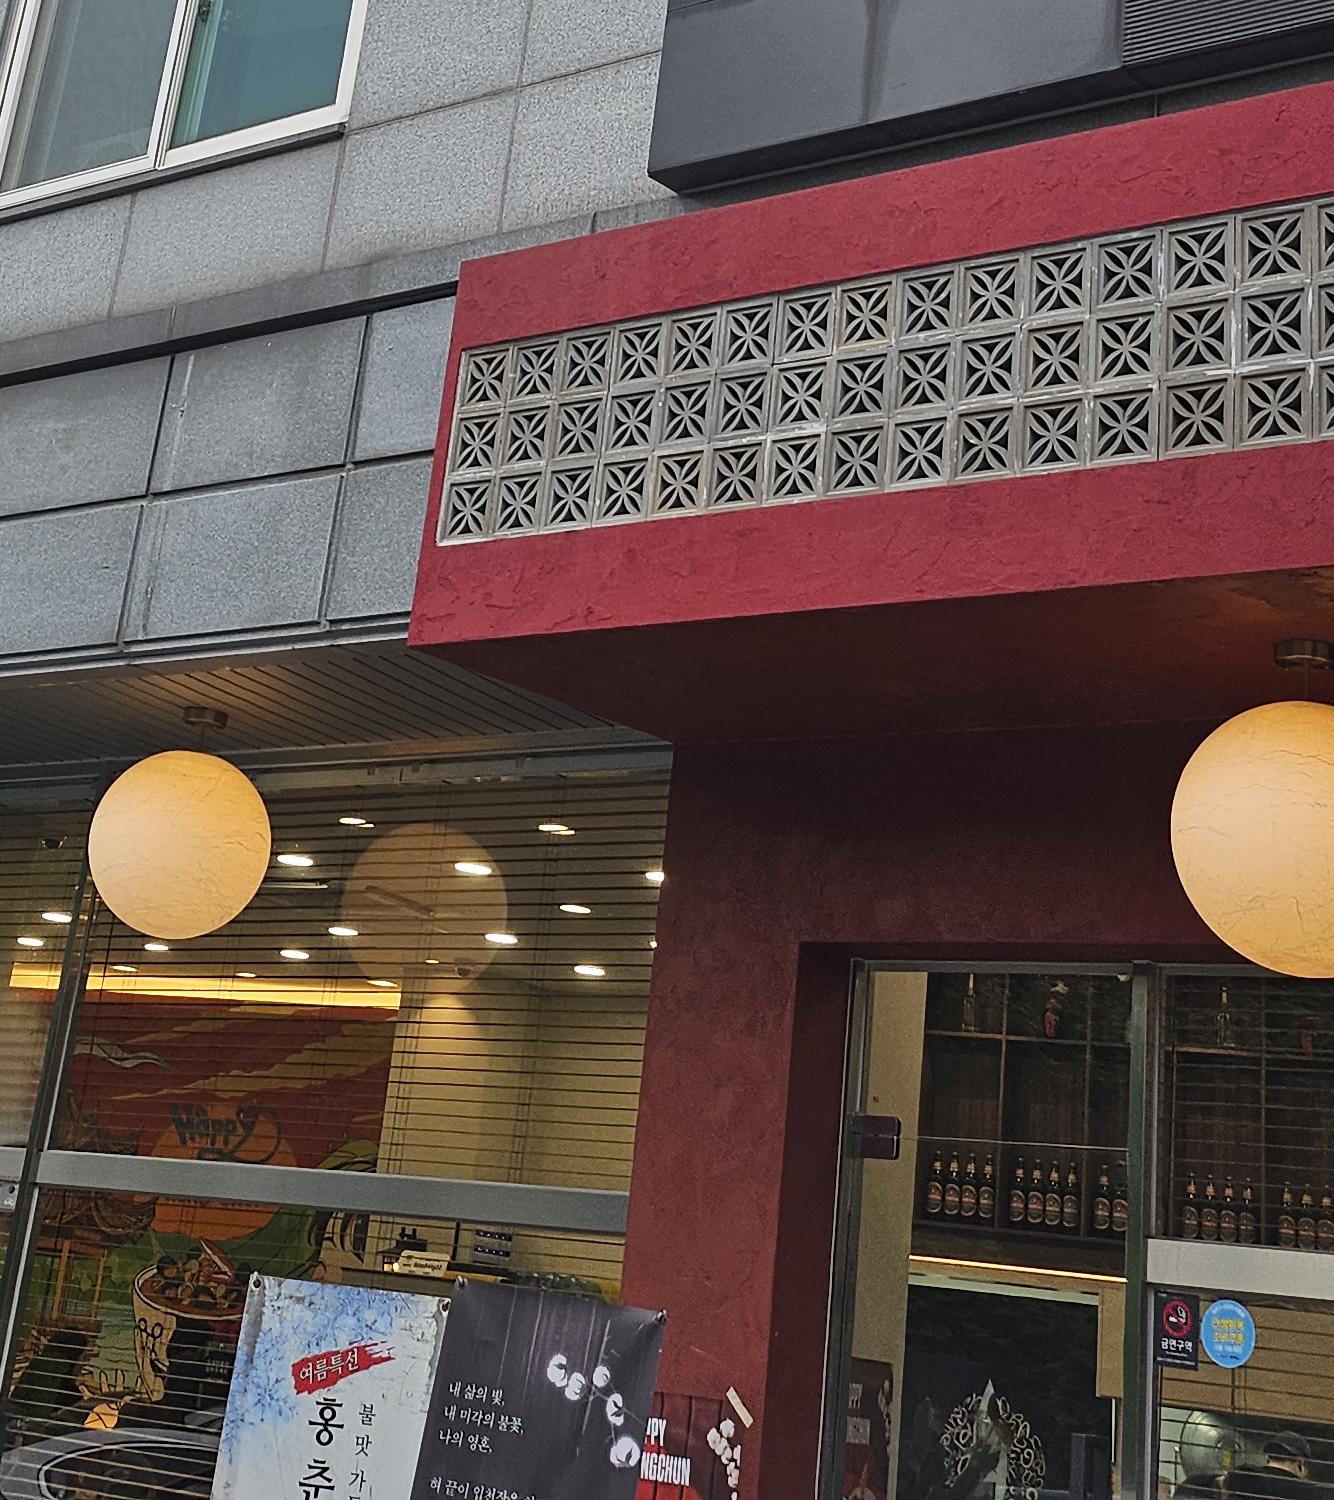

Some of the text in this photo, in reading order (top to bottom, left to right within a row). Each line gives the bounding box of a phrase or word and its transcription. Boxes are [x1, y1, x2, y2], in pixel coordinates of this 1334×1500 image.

[1161, 1337, 1193, 1353] 금연구역
[299, 1347, 359, 1384] 여름특선
[449, 1381, 505, 1407] 내 삶의 빛,
[444, 1405, 456, 1421] 내
[439, 1428, 493, 1454] 나의 영혼,
